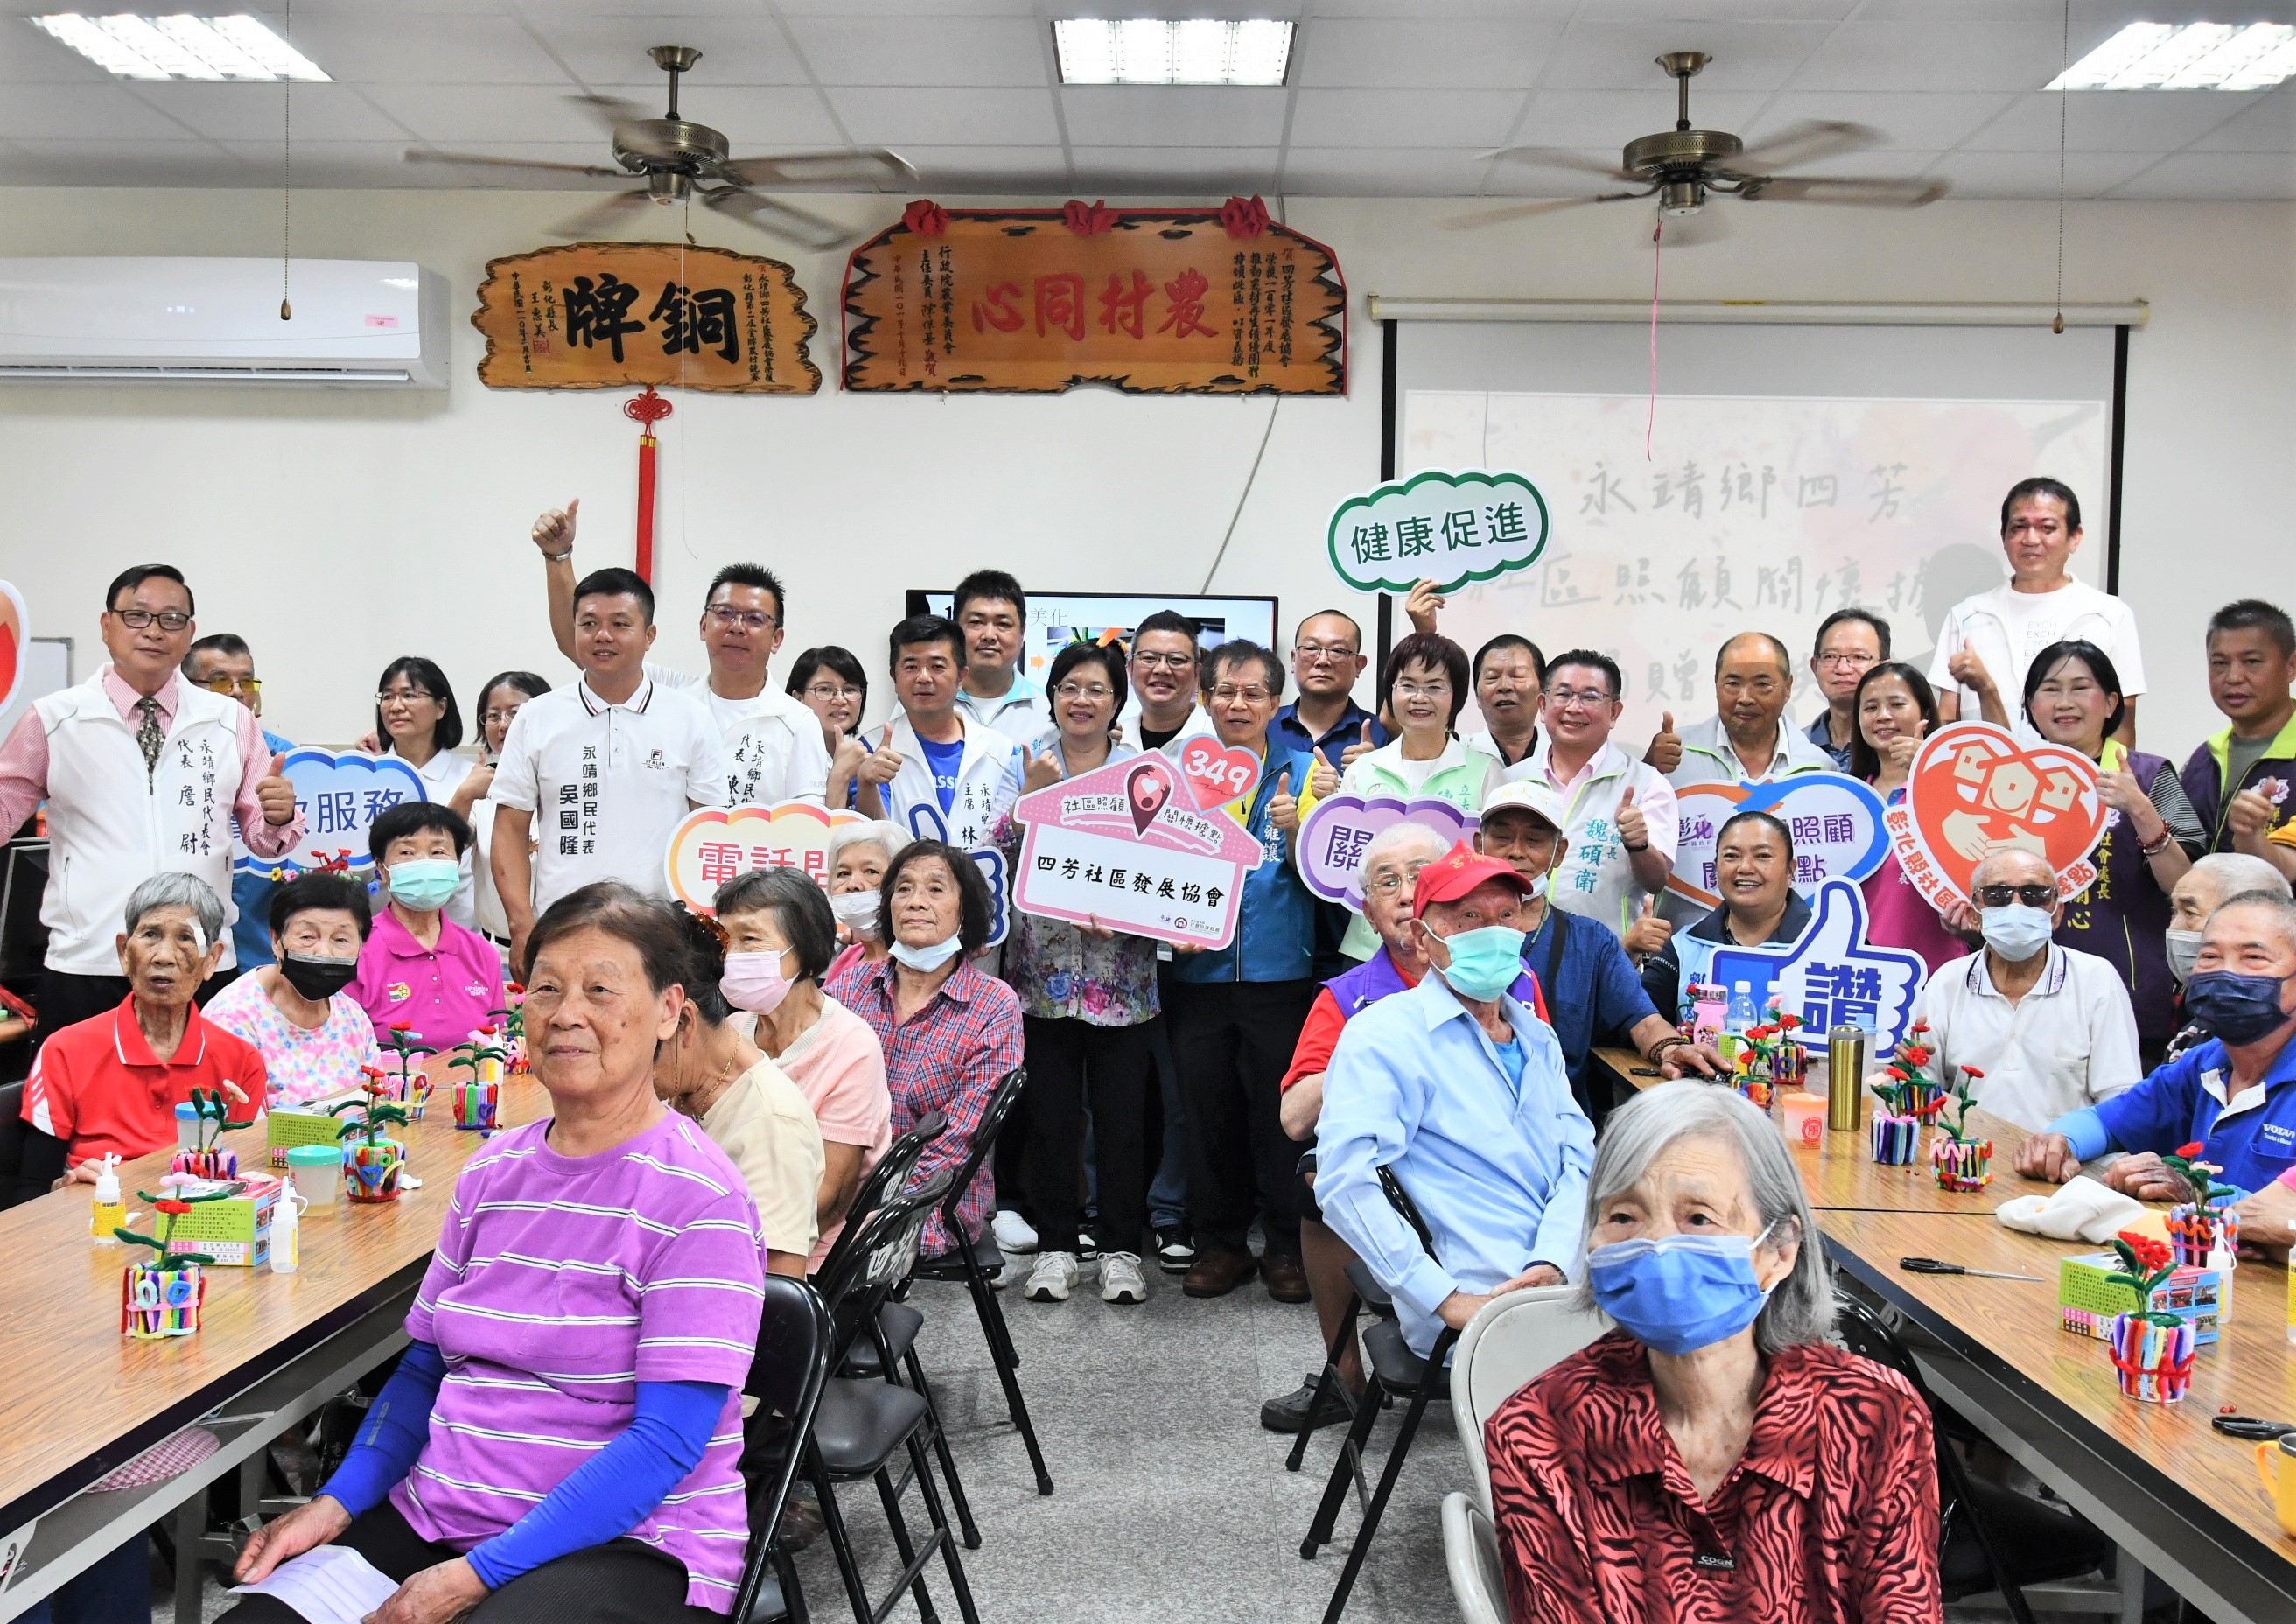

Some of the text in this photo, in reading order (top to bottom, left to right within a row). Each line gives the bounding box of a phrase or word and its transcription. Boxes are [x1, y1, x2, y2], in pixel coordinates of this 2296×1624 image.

[542, 280, 559, 332] 彰化縣長
[938, 245, 956, 355] 行政院農業委員會
[1279, 264, 1295, 368] 四芳社區發展協會
[1578, 460, 1910, 525] 永靖鄉四芳
[1350, 501, 1529, 565] 健康促進
[1028, 607, 1068, 627] 美化
[2026, 630, 2056, 639] EXCH
[178, 738, 195, 769] 代表
[1184, 749, 1252, 794] 349
[200, 739, 216, 857] 永靖鄉民代表會
[559, 784, 579, 856] 吳國隆
[582, 746, 598, 855] 永靖鄉民代表
[963, 782, 976, 811] 主席
[1063, 796, 1125, 815] 社區照顧
[1163, 807, 1222, 844] 關懷據點
[1037, 855, 1226, 908] 四芳社區發展協會
[1802, 961, 1883, 1036] 讚
